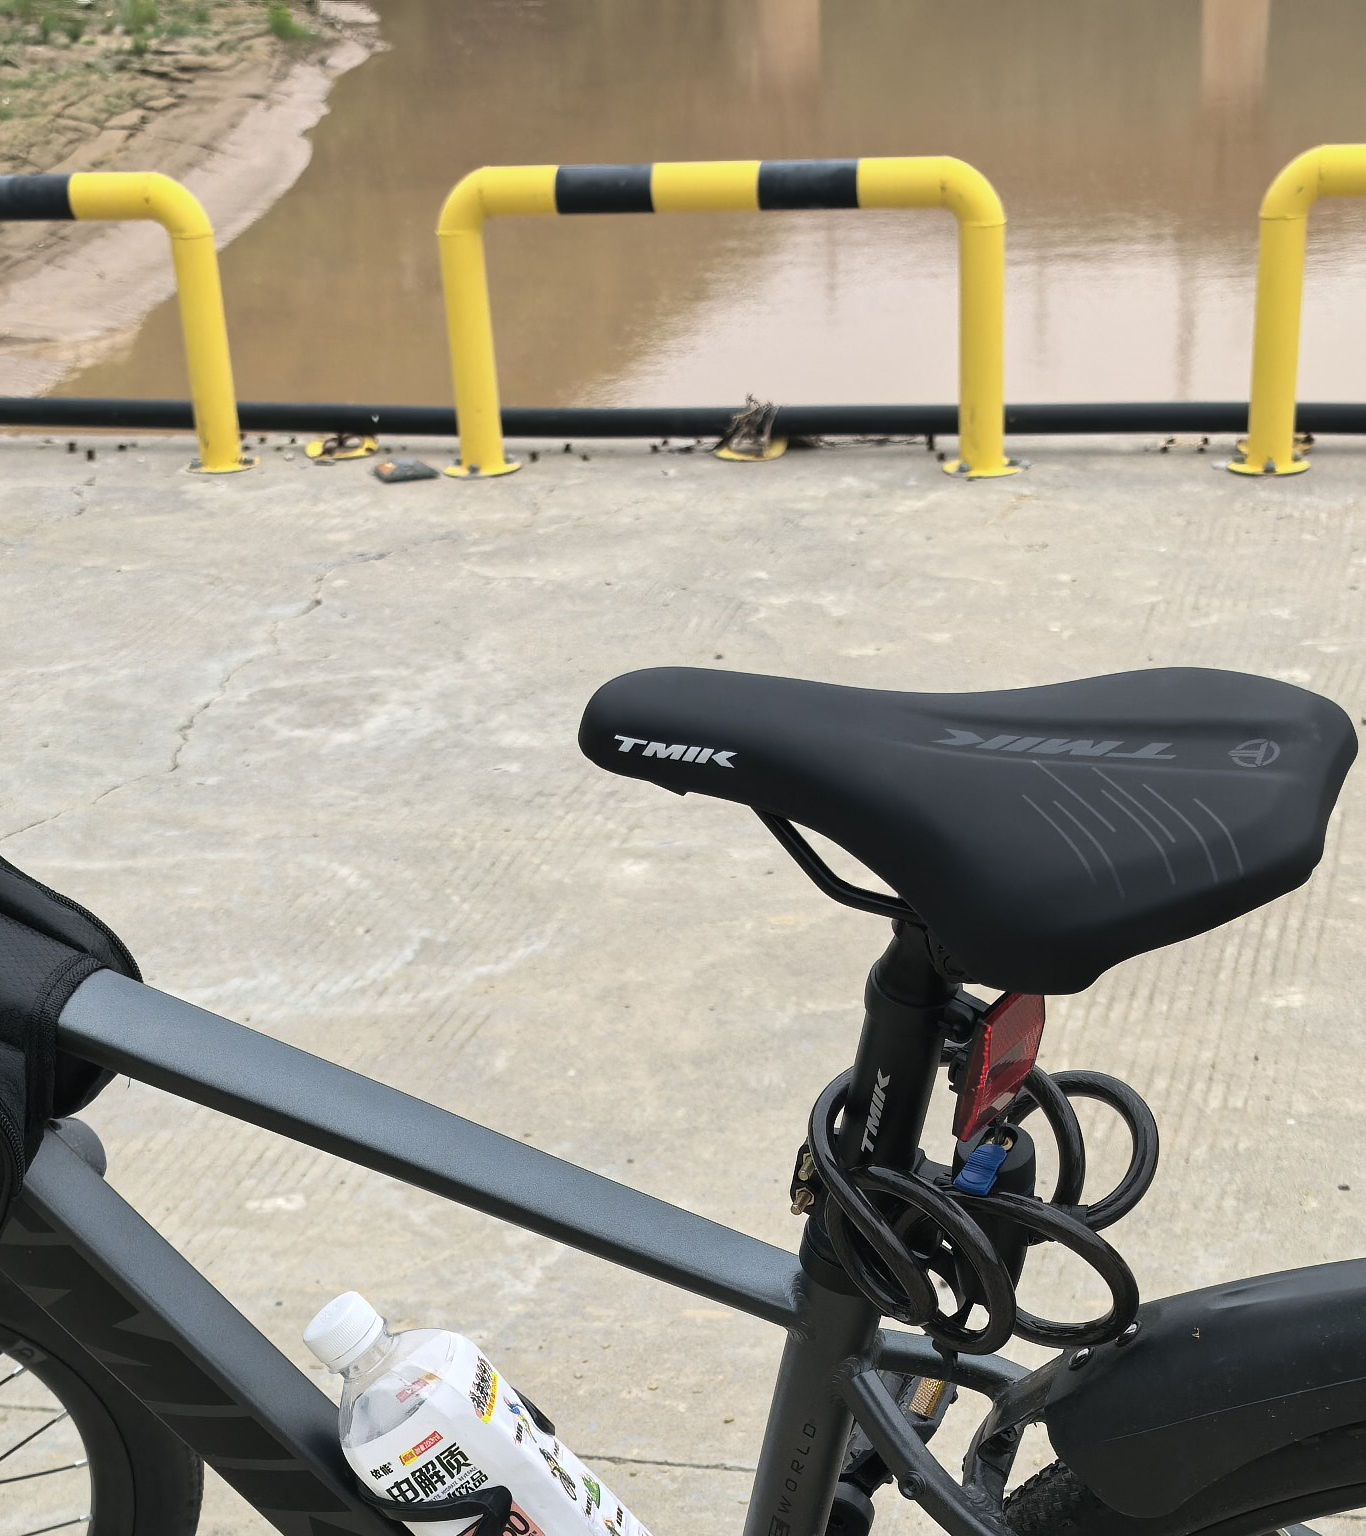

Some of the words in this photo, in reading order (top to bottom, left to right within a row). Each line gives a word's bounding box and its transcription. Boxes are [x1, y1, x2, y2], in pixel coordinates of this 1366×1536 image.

[613, 734, 738, 769] TMIK
[930, 728, 1177, 760] TMIK
[860, 1067, 891, 1153] TMIK
[386, 1442, 473, 1503] 电解质
[778, 1423, 817, 1514] WORLD
